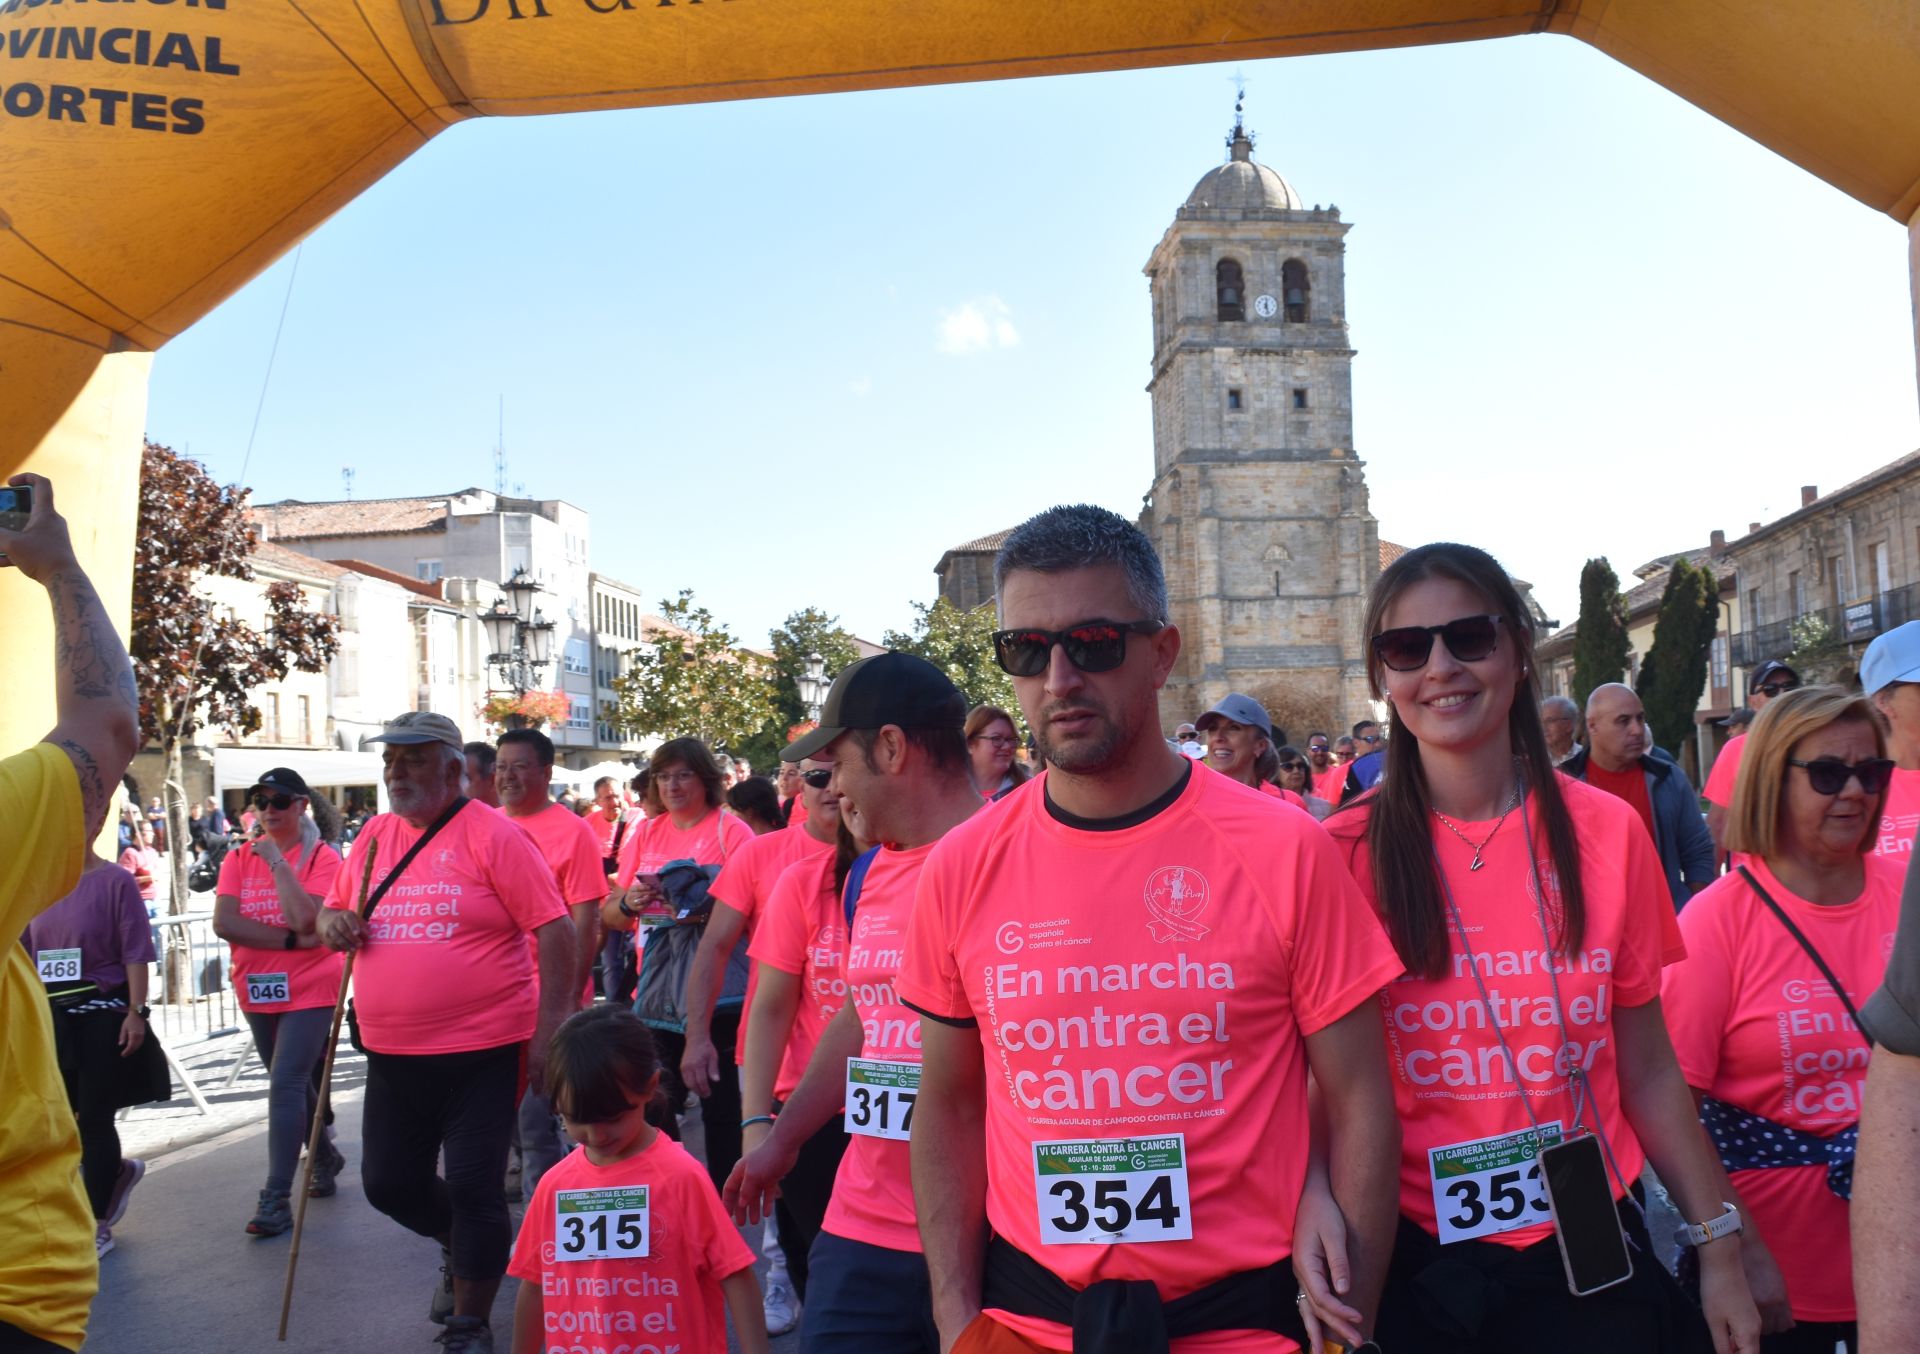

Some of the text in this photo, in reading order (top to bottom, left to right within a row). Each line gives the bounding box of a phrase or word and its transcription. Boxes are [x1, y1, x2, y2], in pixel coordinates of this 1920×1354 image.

[0, 27, 240, 76] VINCIAL
[0, 82, 205, 135] ORTES
[396, 881, 462, 896] marcha
[240, 898, 281, 914] contr
[371, 899, 459, 917] contra el
[369, 919, 459, 939] cáncer
[1028, 918, 1070, 928] asociación
[1029, 929, 1064, 940] española
[1028, 941, 1054, 950] contra
[1064, 936, 1092, 946] cáncer
[42, 961, 78, 978] 468
[815, 948, 842, 967] En
[848, 945, 870, 968] En
[1453, 946, 1612, 978] marcha
[997, 953, 1235, 998] En marcha
[250, 984, 286, 1000] 046
[851, 977, 904, 1006] con
[984, 966, 998, 1026] CAMPOO
[1384, 1010, 1396, 1027] DE
[1394, 990, 1562, 1032] contra
[1568, 984, 1607, 1026] el
[863, 1010, 922, 1048] ánc
[1000, 1002, 1230, 1052] contra el
[1789, 1008, 1836, 1036] En
[994, 1028, 1003, 1046] DE
[1405, 1034, 1607, 1086] cáncer
[1794, 1046, 1870, 1074] con
[1015, 1054, 1233, 1110] cáncer
[852, 1088, 917, 1132] 317
[1092, 1118, 1103, 1126] DE
[1148, 1112, 1182, 1122] CONTRA
[1184, 1111, 1193, 1120] EL
[1194, 1108, 1226, 1118] CÁNCER
[1040, 1140, 1178, 1156] VI CARRERA CONTRA EL CANCER
[1435, 1152, 1444, 1161] VI
[1446, 1145, 1484, 1160] CARRERA
[1518, 1135, 1526, 1144] EL
[1462, 1155, 1488, 1164] AGUILAR
[1497, 1147, 1518, 1157] CAMPOO
[1050, 1175, 1180, 1233] 354
[563, 1214, 642, 1252] 315
[542, 1272, 679, 1298] En marcha
[544, 1302, 677, 1335] contra el
